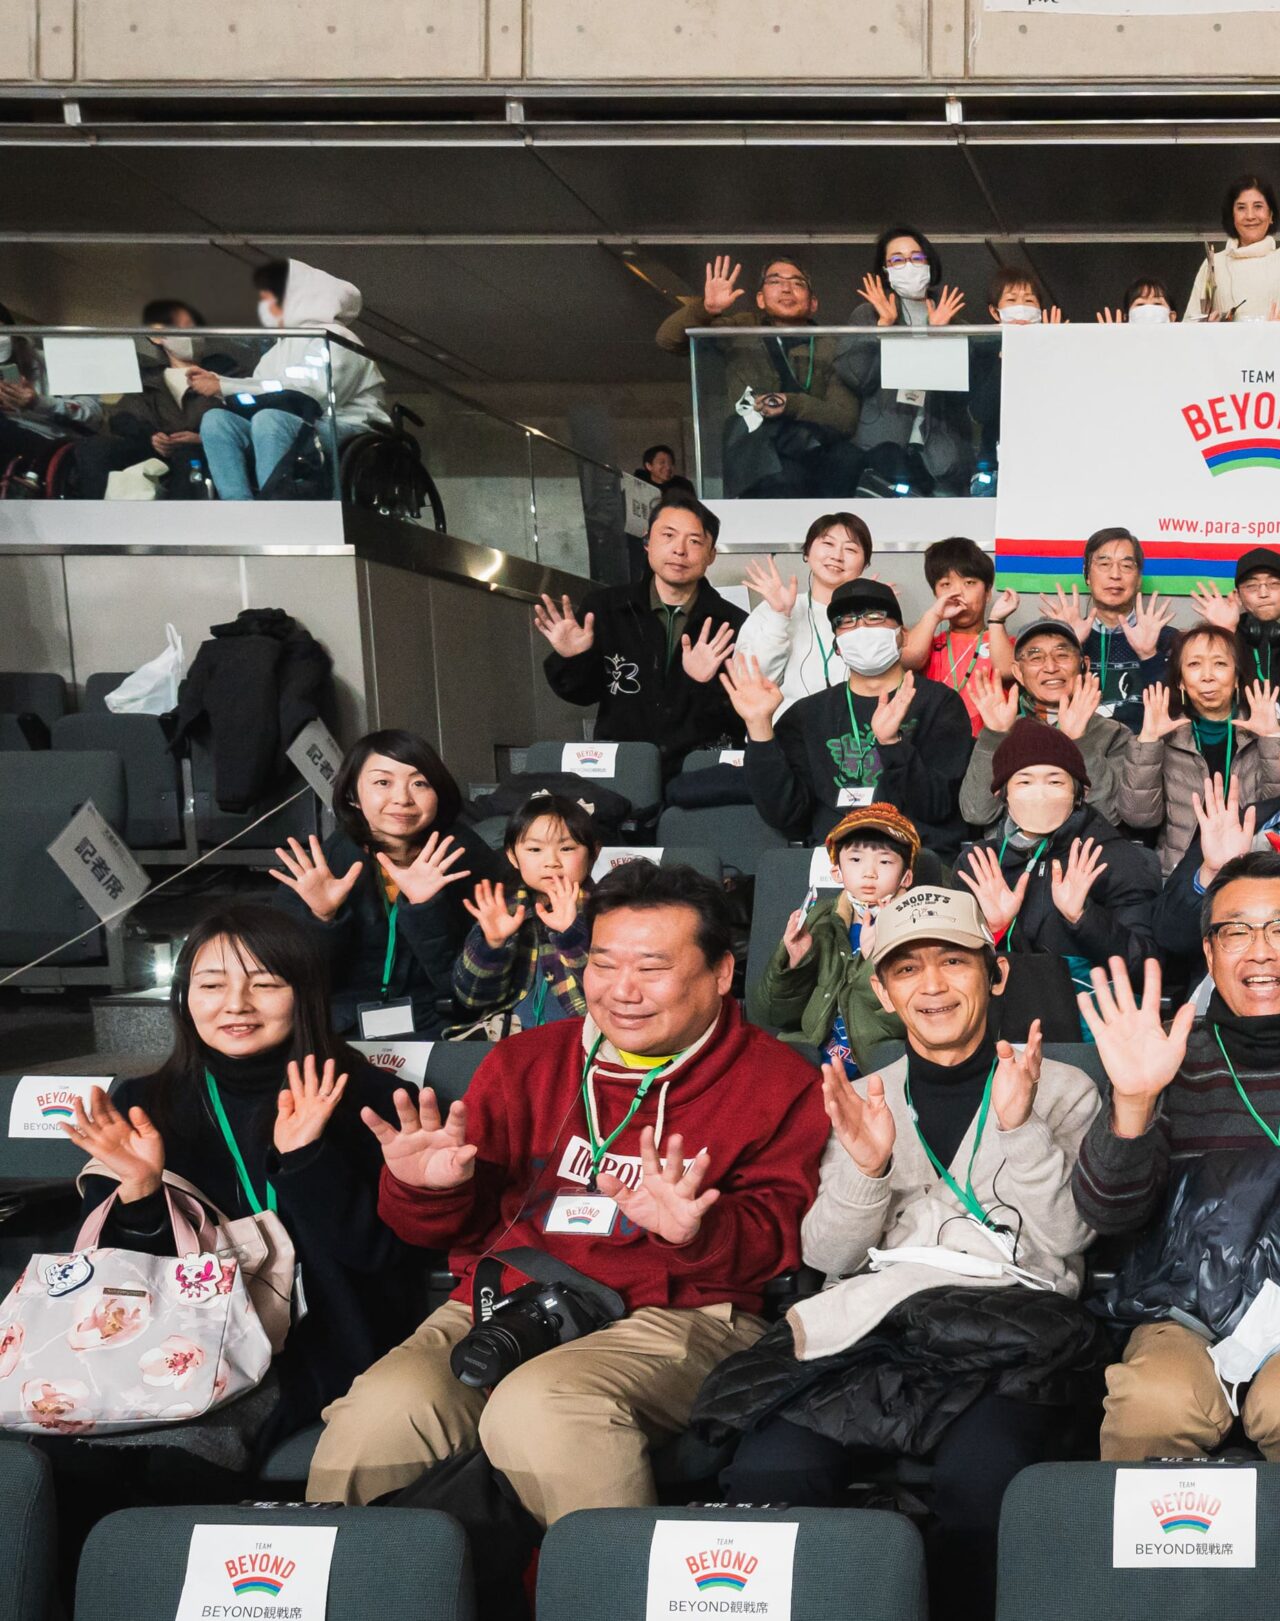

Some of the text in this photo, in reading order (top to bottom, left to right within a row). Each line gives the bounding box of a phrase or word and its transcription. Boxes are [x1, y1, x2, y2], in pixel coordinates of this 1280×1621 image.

[1241, 370, 1275, 383] TEAM
[305, 743, 337, 785] 記者
[74, 836, 125, 900] 記者席
[895, 893, 951, 912] SNOOPY'S
[368, 1053, 406, 1069] EYOND
[36, 1091, 82, 1107] BEYON
[480, 1286, 494, 1322] Can
[1150, 1491, 1222, 1517] BEYOND
[1135, 1543, 1234, 1555] BEYOND観戦席
[225, 1553, 296, 1579] BEYOND
[685, 1549, 759, 1575] BEYOND
[201, 1605, 302, 1619] BEYOND観戦席
[669, 1600, 769, 1614] BEYOND観戦席
